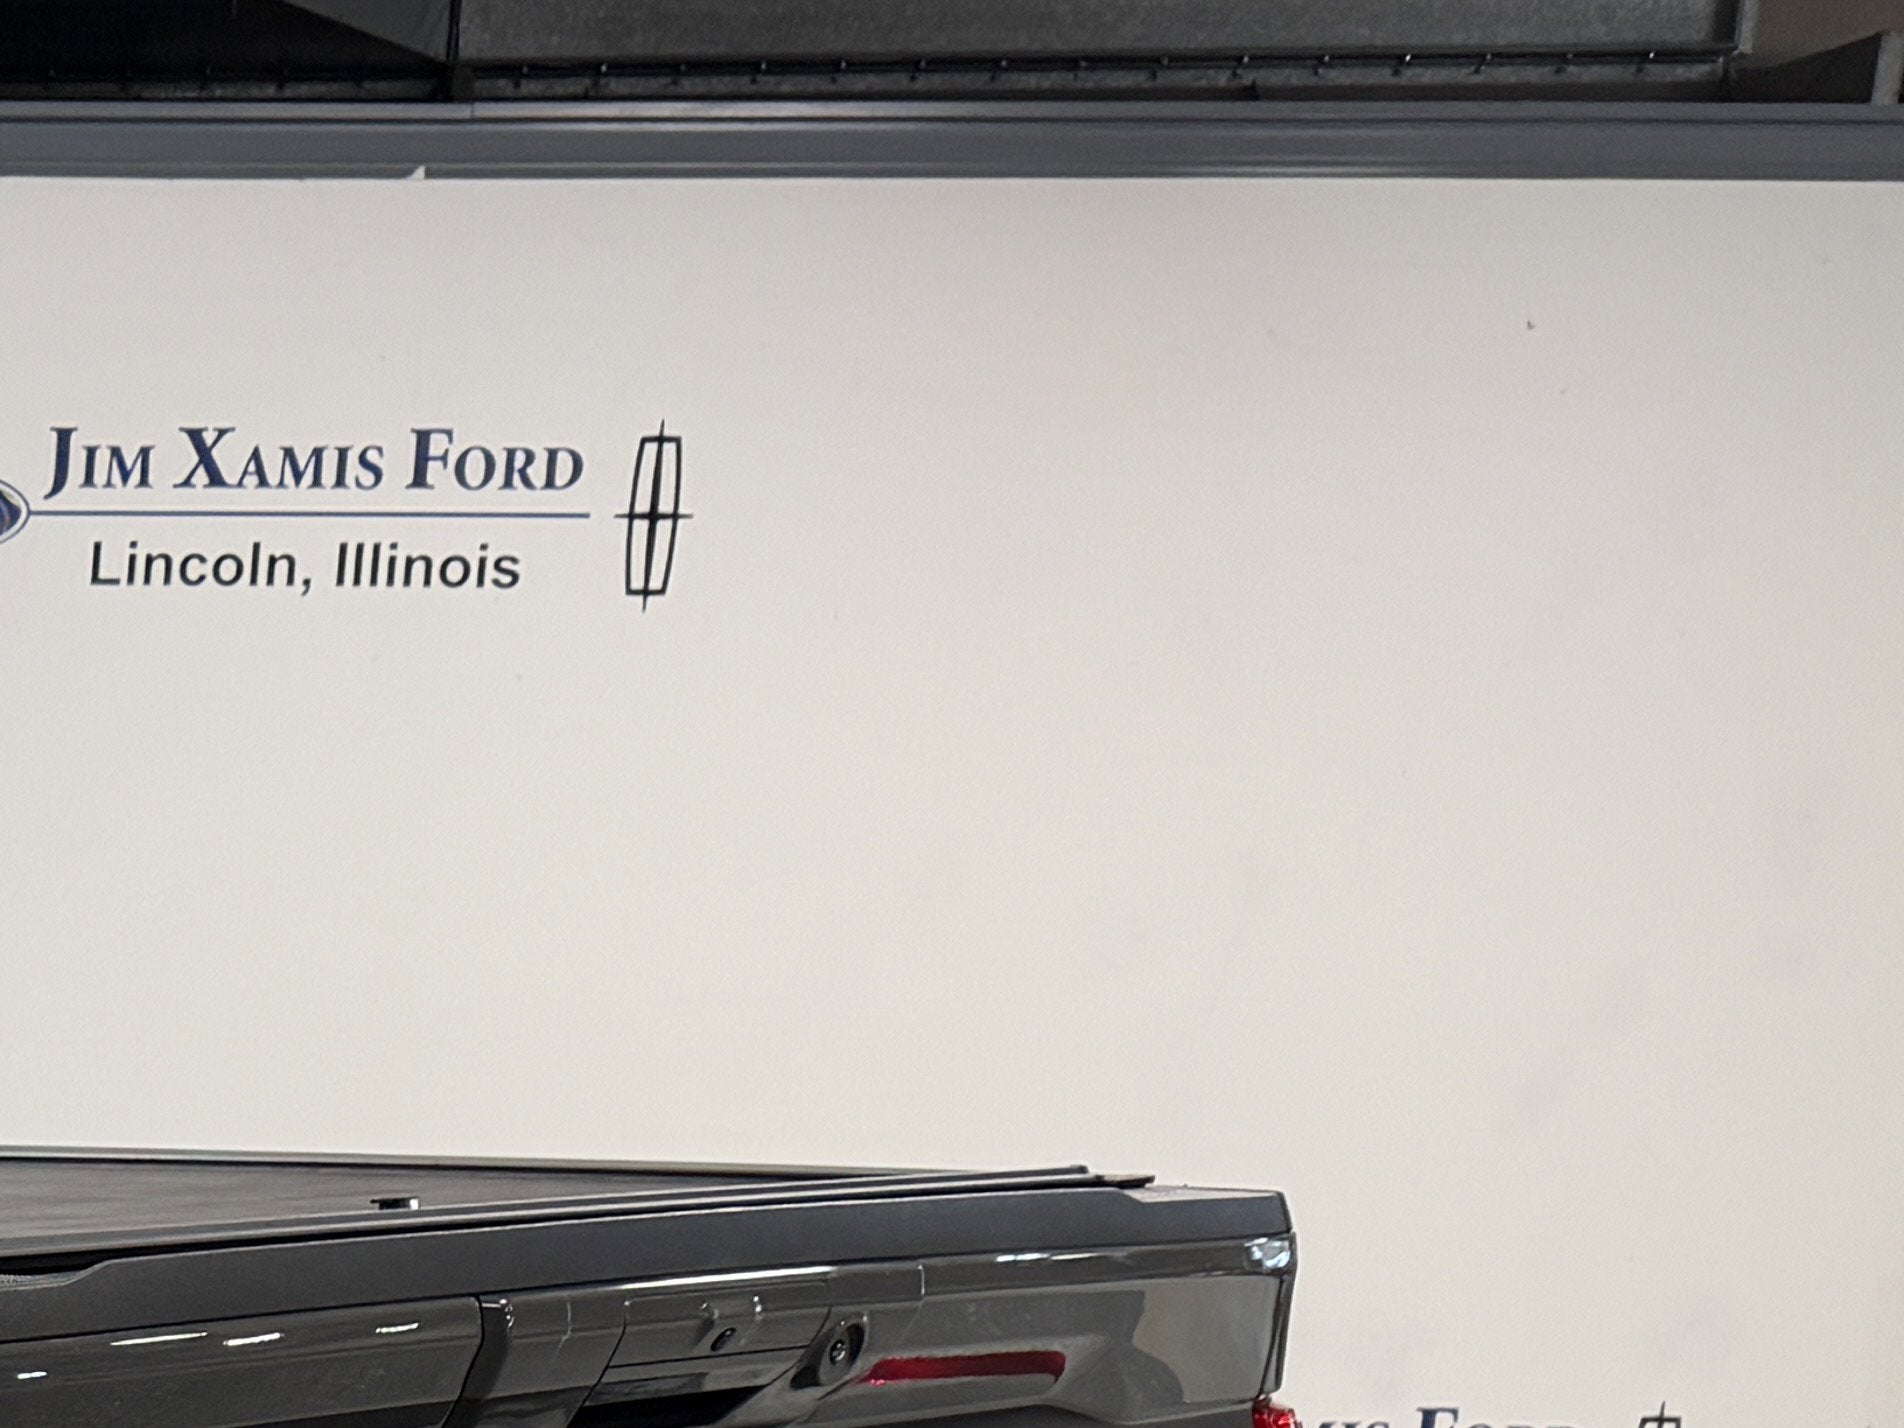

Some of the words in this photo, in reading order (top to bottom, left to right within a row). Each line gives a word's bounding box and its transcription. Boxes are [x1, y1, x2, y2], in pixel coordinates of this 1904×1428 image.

[43, 426, 154, 499] JIM
[174, 427, 384, 490] XAMIS
[404, 428, 585, 491] FORD
[89, 541, 313, 595] Lincoln,
[334, 543, 521, 590] Illinois
